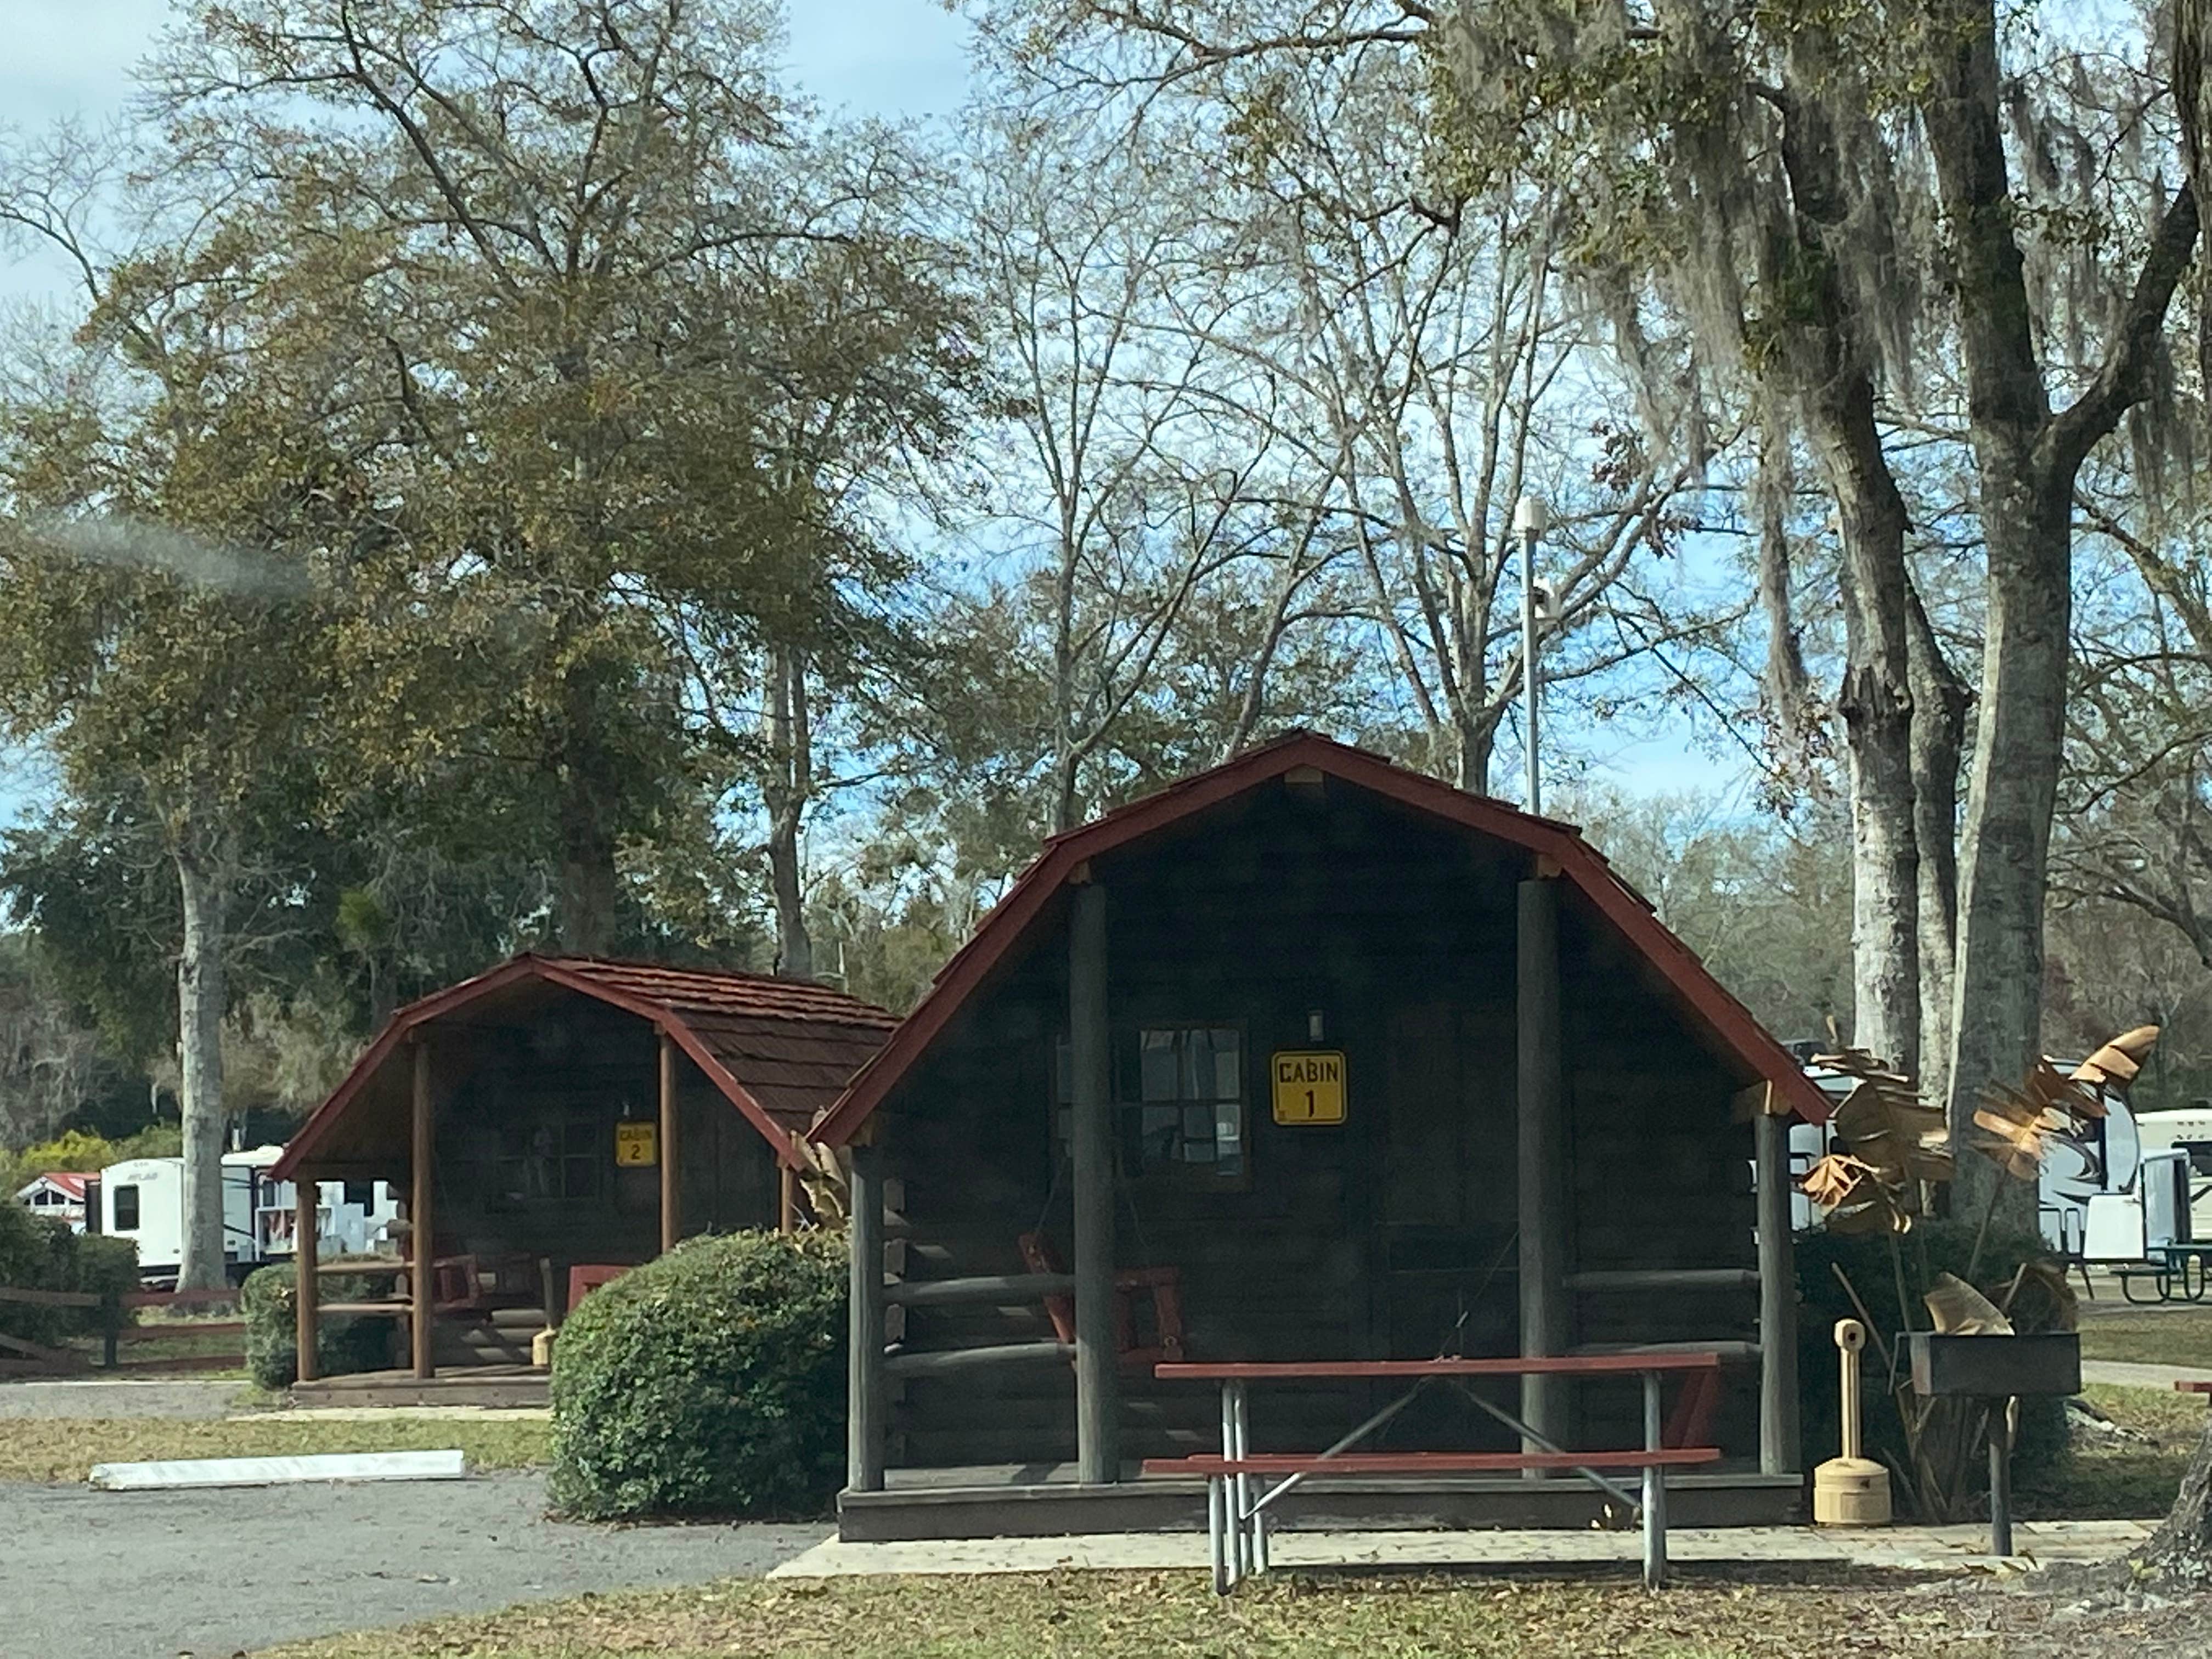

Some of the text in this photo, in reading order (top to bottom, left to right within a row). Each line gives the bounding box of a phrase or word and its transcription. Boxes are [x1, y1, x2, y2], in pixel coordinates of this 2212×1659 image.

[1279, 1060, 1338, 1082] CABIN
[1305, 1090, 1314, 1117] 1
[631, 1144, 641, 1159] 2
